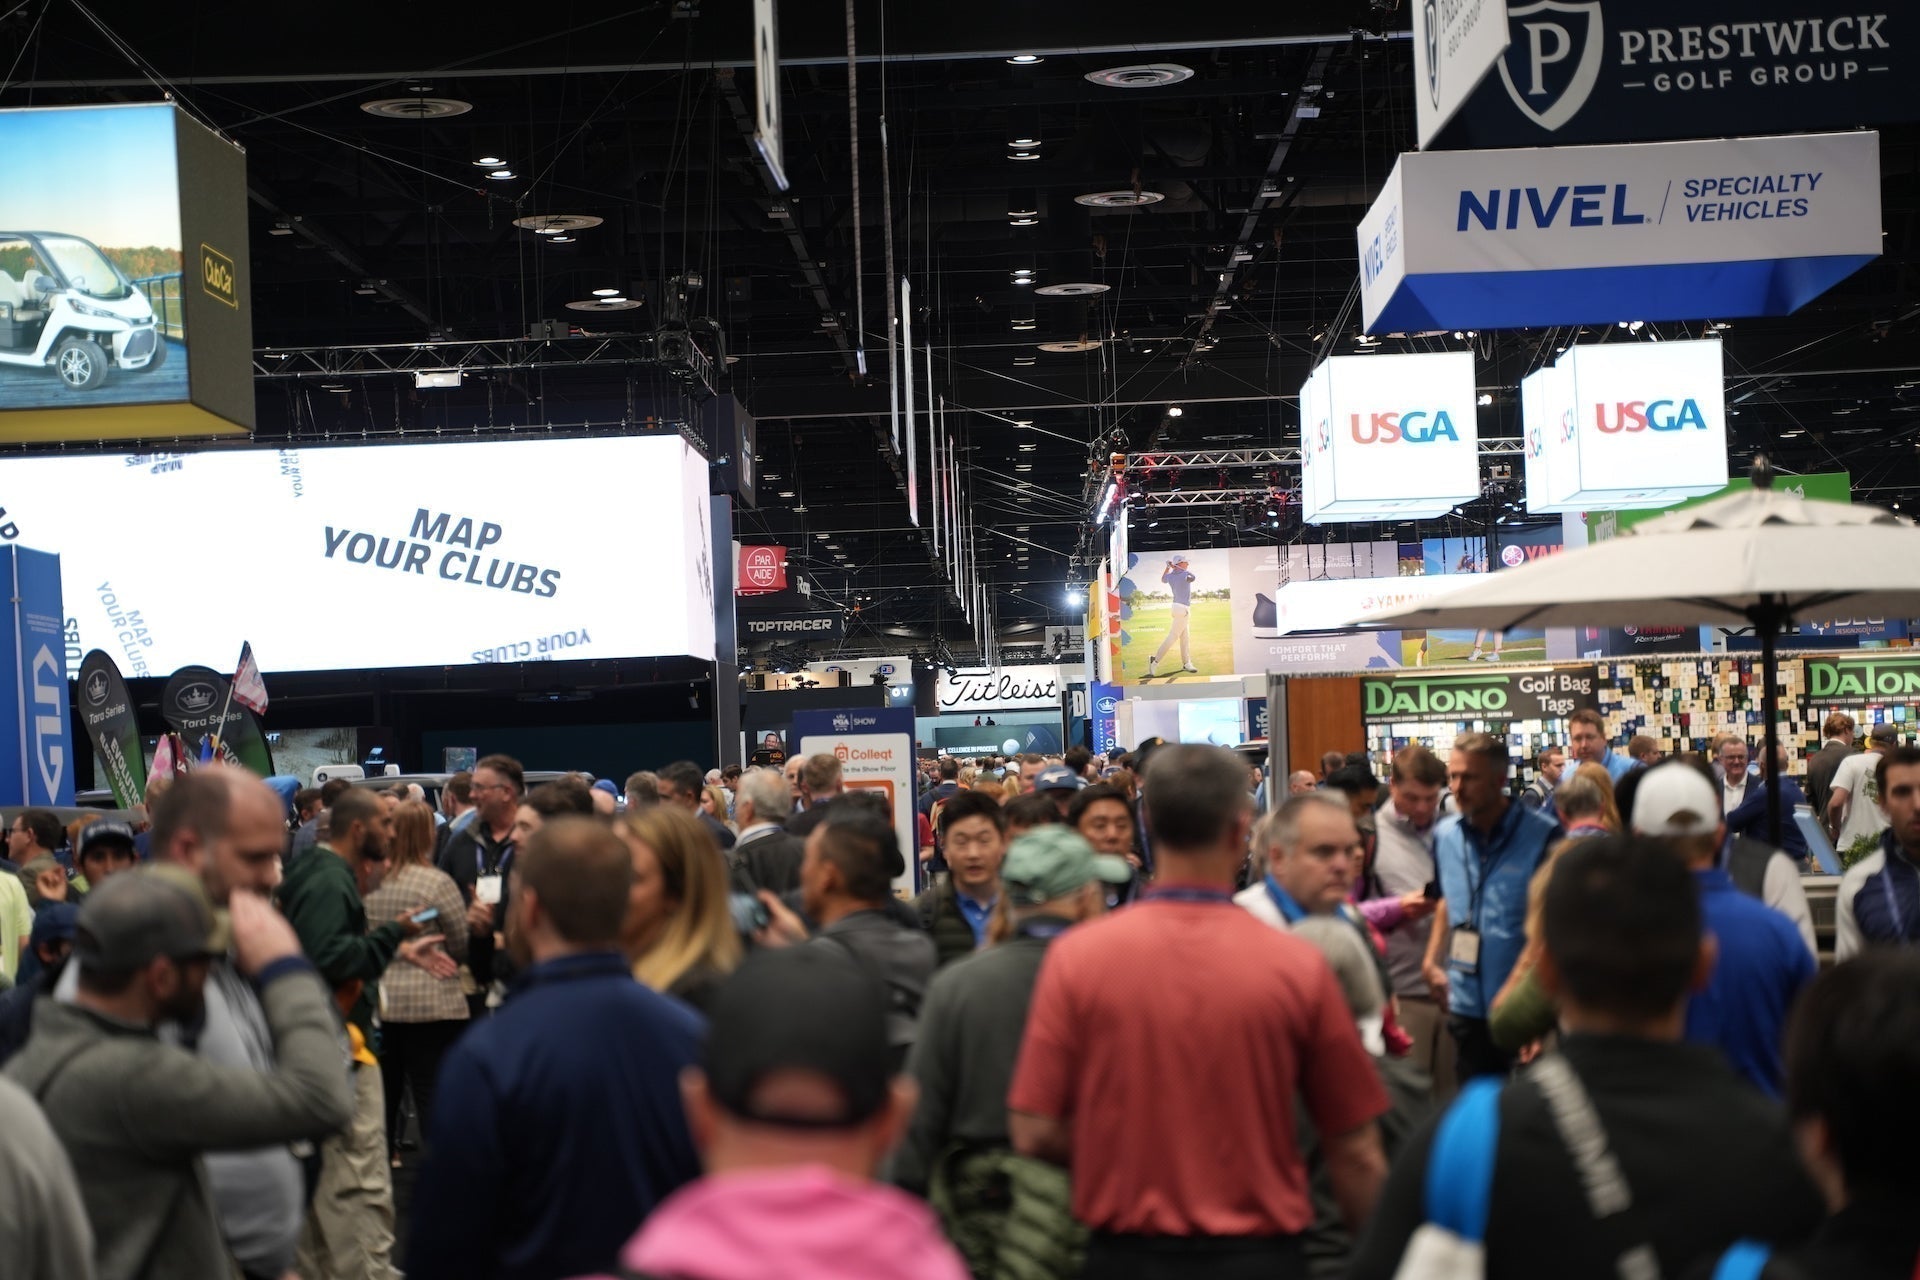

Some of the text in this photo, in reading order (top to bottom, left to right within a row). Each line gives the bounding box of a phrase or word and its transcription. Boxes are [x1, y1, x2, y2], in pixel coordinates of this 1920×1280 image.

[1619, 14, 1890, 65] PRESTWICK
[1653, 61, 1859, 93] GOLF GROUP
[1456, 172, 1823, 232] NIVEL SPECIALTY
[1685, 198, 1809, 223] VEHICLES
[1351, 411, 1459, 444] USGA
[1596, 398, 1708, 434] USGA
[290, 467, 304, 498] YOUR
[409, 508, 502, 551] MAP
[324, 526, 561, 598] YOUR CLUBS
[755, 555, 771, 565] PAR
[753, 569, 772, 579] AIDE
[96, 581, 151, 678] YOUR CLUBS
[126, 610, 153, 647] MAP
[748, 619, 832, 632] TOPTRACER
[537, 628, 592, 653] YOUR
[1269, 643, 1347, 656] COMFORT THAT
[1281, 653, 1337, 662] PERFORMS
[942, 671, 1056, 706] Titleist
[1519, 675, 1591, 694] Golf Bag
[89, 703, 126, 725] Tara Series
[1537, 695, 1575, 716] Tags
[181, 718, 207, 729] Tara
[853, 717, 877, 726] SHOW
[851, 748, 893, 761] Colleqt
[880, 765, 896, 773] Floor
